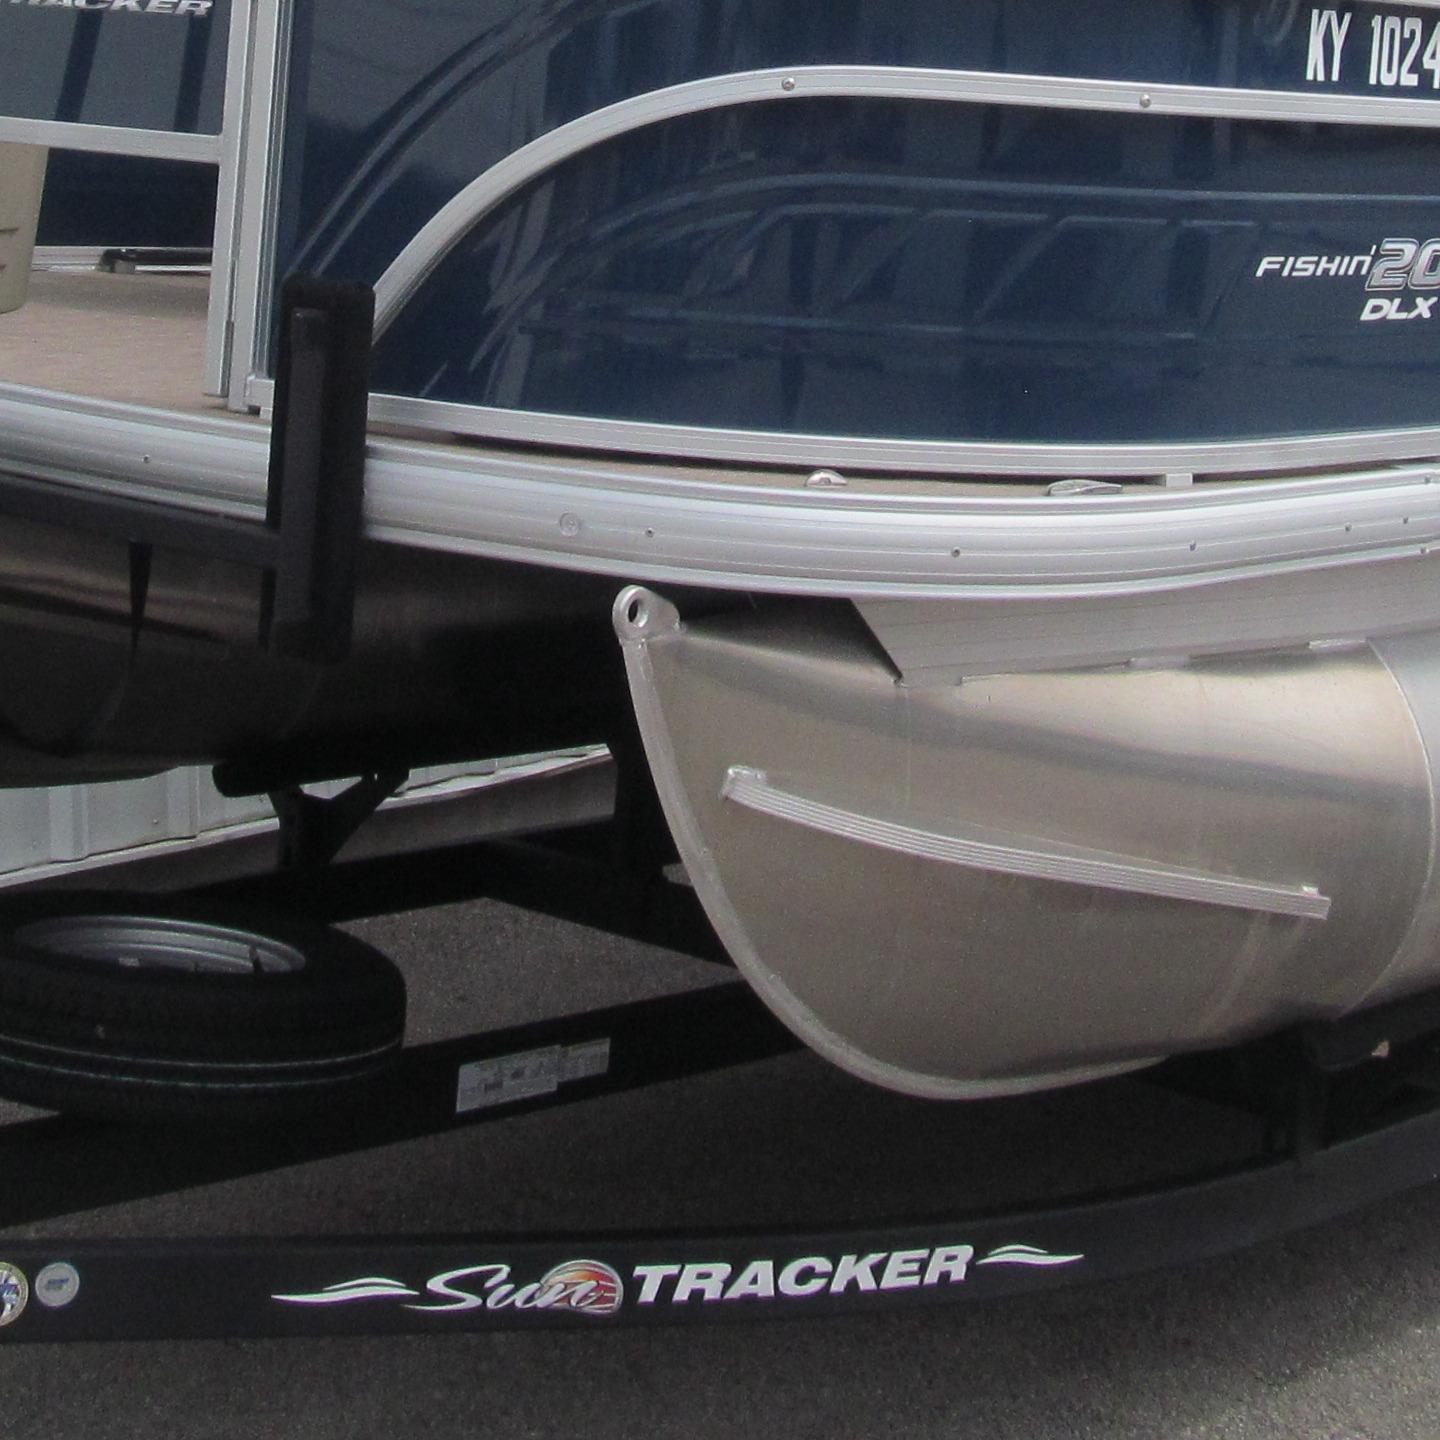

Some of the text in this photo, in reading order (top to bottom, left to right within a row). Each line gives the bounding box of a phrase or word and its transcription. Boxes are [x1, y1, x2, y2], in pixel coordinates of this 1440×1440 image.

[1306, 8, 1352, 82] KY
[1255, 244, 1377, 277] FISHIN'
[1359, 296, 1438, 321] DLX
[400, 1244, 975, 1311] Sun TRACKER
